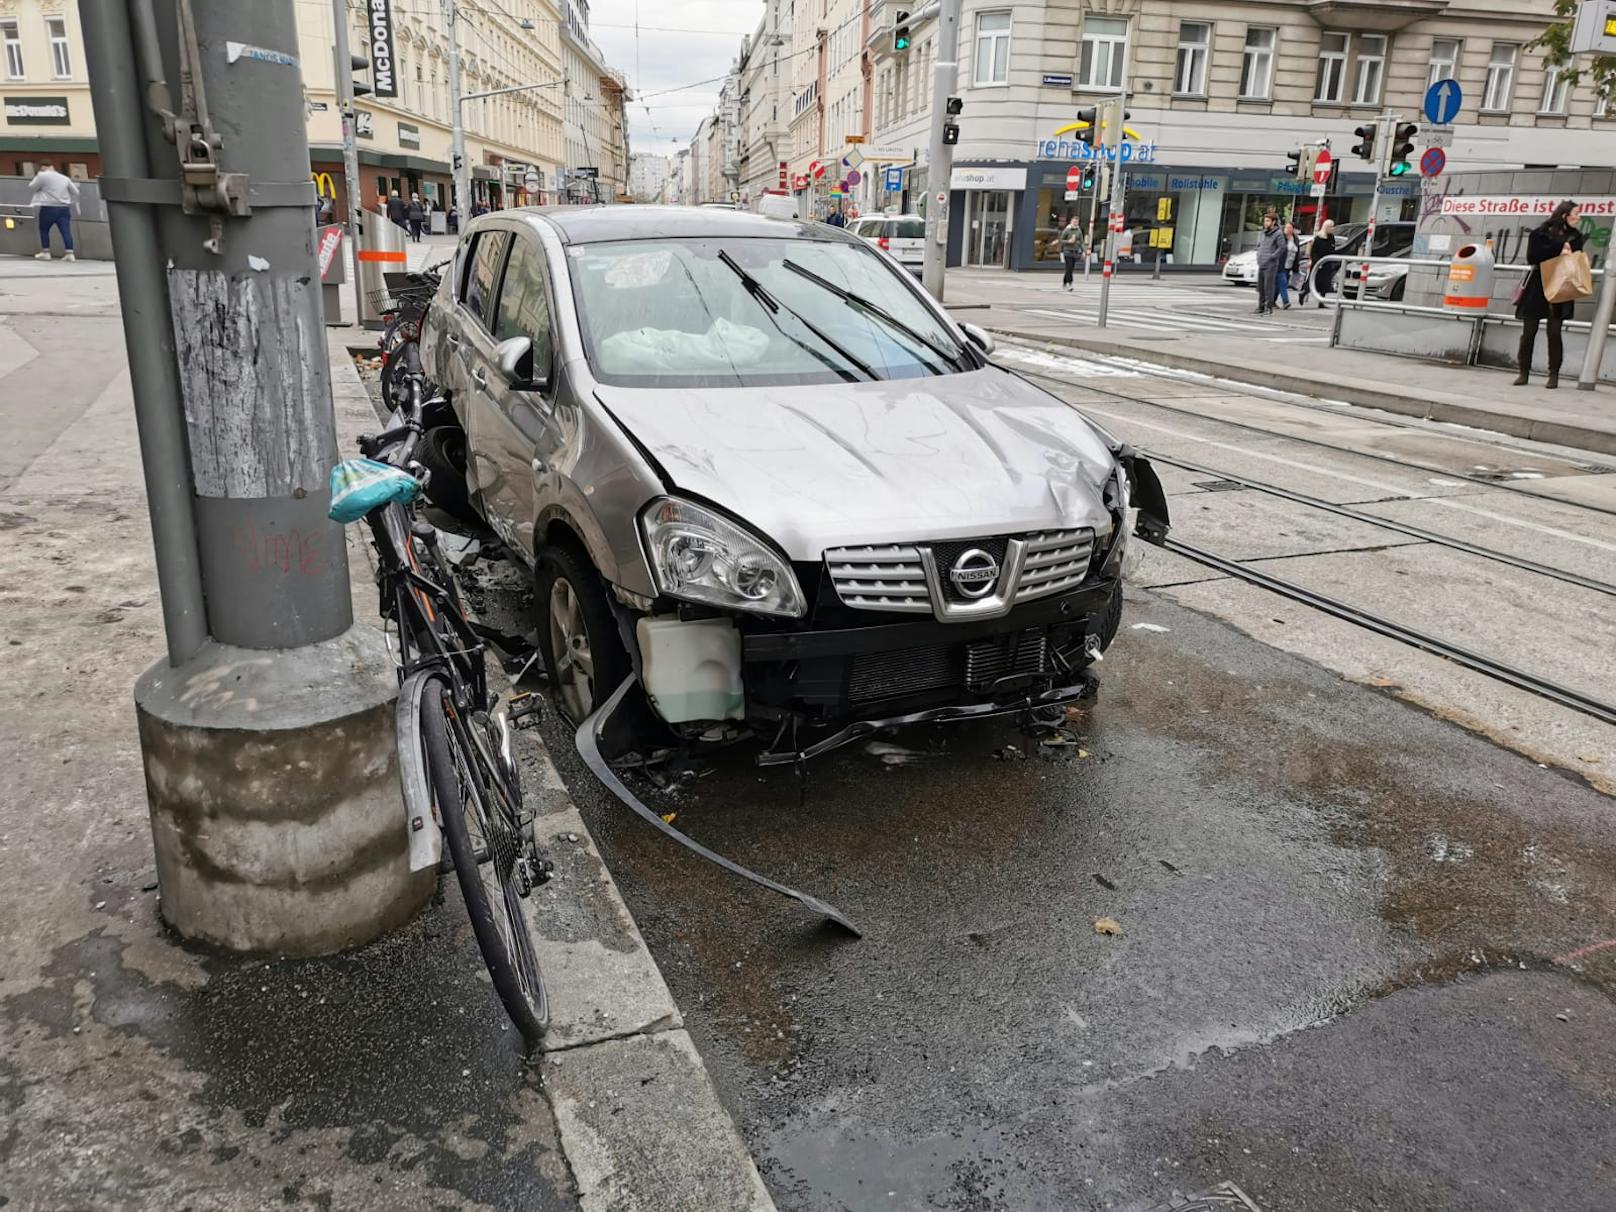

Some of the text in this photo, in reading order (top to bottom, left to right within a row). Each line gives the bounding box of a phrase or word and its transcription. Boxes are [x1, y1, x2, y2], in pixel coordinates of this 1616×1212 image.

[1443, 200, 1476, 213] Diese
[1478, 198, 1529, 213] Straße
[1533, 198, 1554, 213] ist
[958, 567, 997, 580] NISSAN
